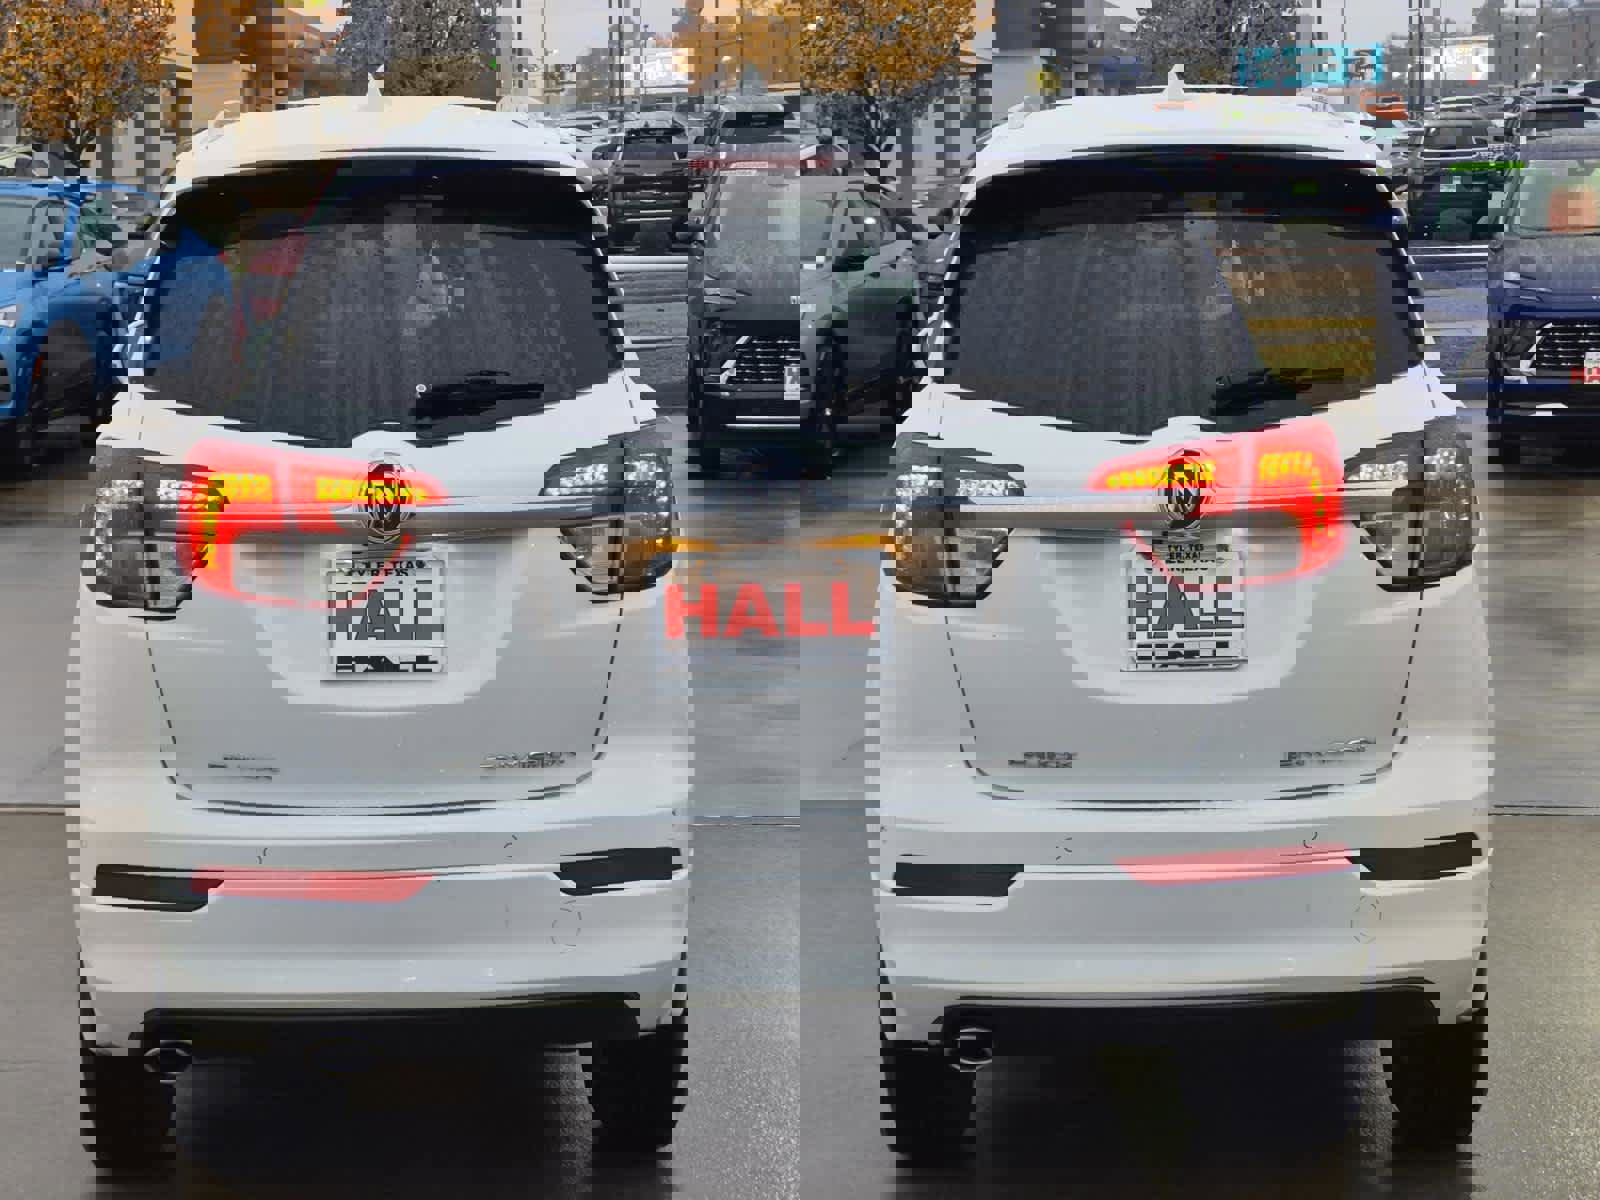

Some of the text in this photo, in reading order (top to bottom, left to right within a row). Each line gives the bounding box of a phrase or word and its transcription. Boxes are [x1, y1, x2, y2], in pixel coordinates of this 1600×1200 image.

[772, 551, 805, 560] TEXAS
[774, 560, 825, 571] TEXAS
[664, 580, 877, 640] HALL
[673, 649, 871, 669] HALL
[431, 754, 552, 774] BUICK
[966, 744, 1142, 769] ENVISION
